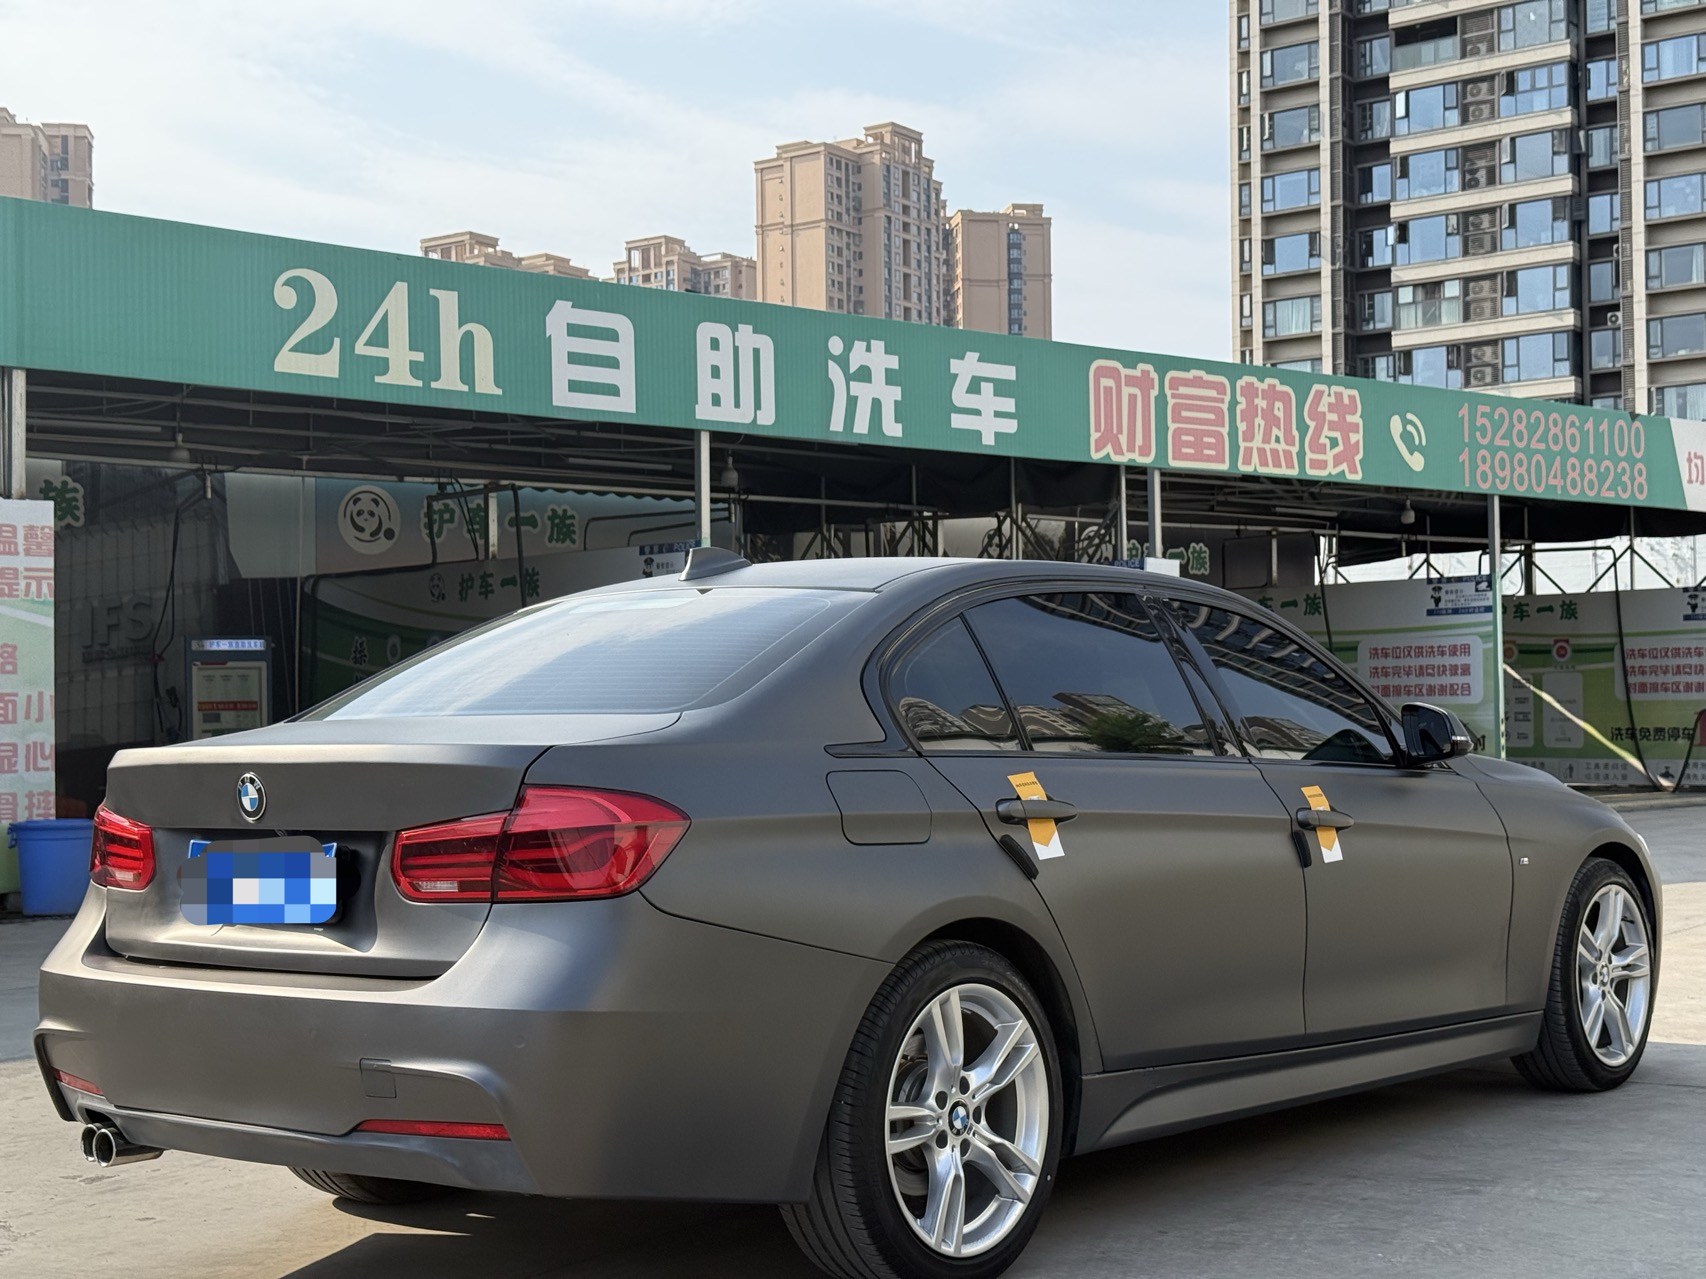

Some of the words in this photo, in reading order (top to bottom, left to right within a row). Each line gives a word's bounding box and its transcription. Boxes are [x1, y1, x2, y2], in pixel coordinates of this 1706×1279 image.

[273, 268, 503, 396] 24h
[546, 300, 1018, 446] 自助洗车
[1090, 360, 1362, 479] 财富热线
[1458, 403, 1645, 459] 15282861100
[1459, 447, 1648, 500] 18980488238
[1502, 599, 1579, 622] 车一族
[1369, 643, 1471, 660] 洗车位仅供洗车使用
